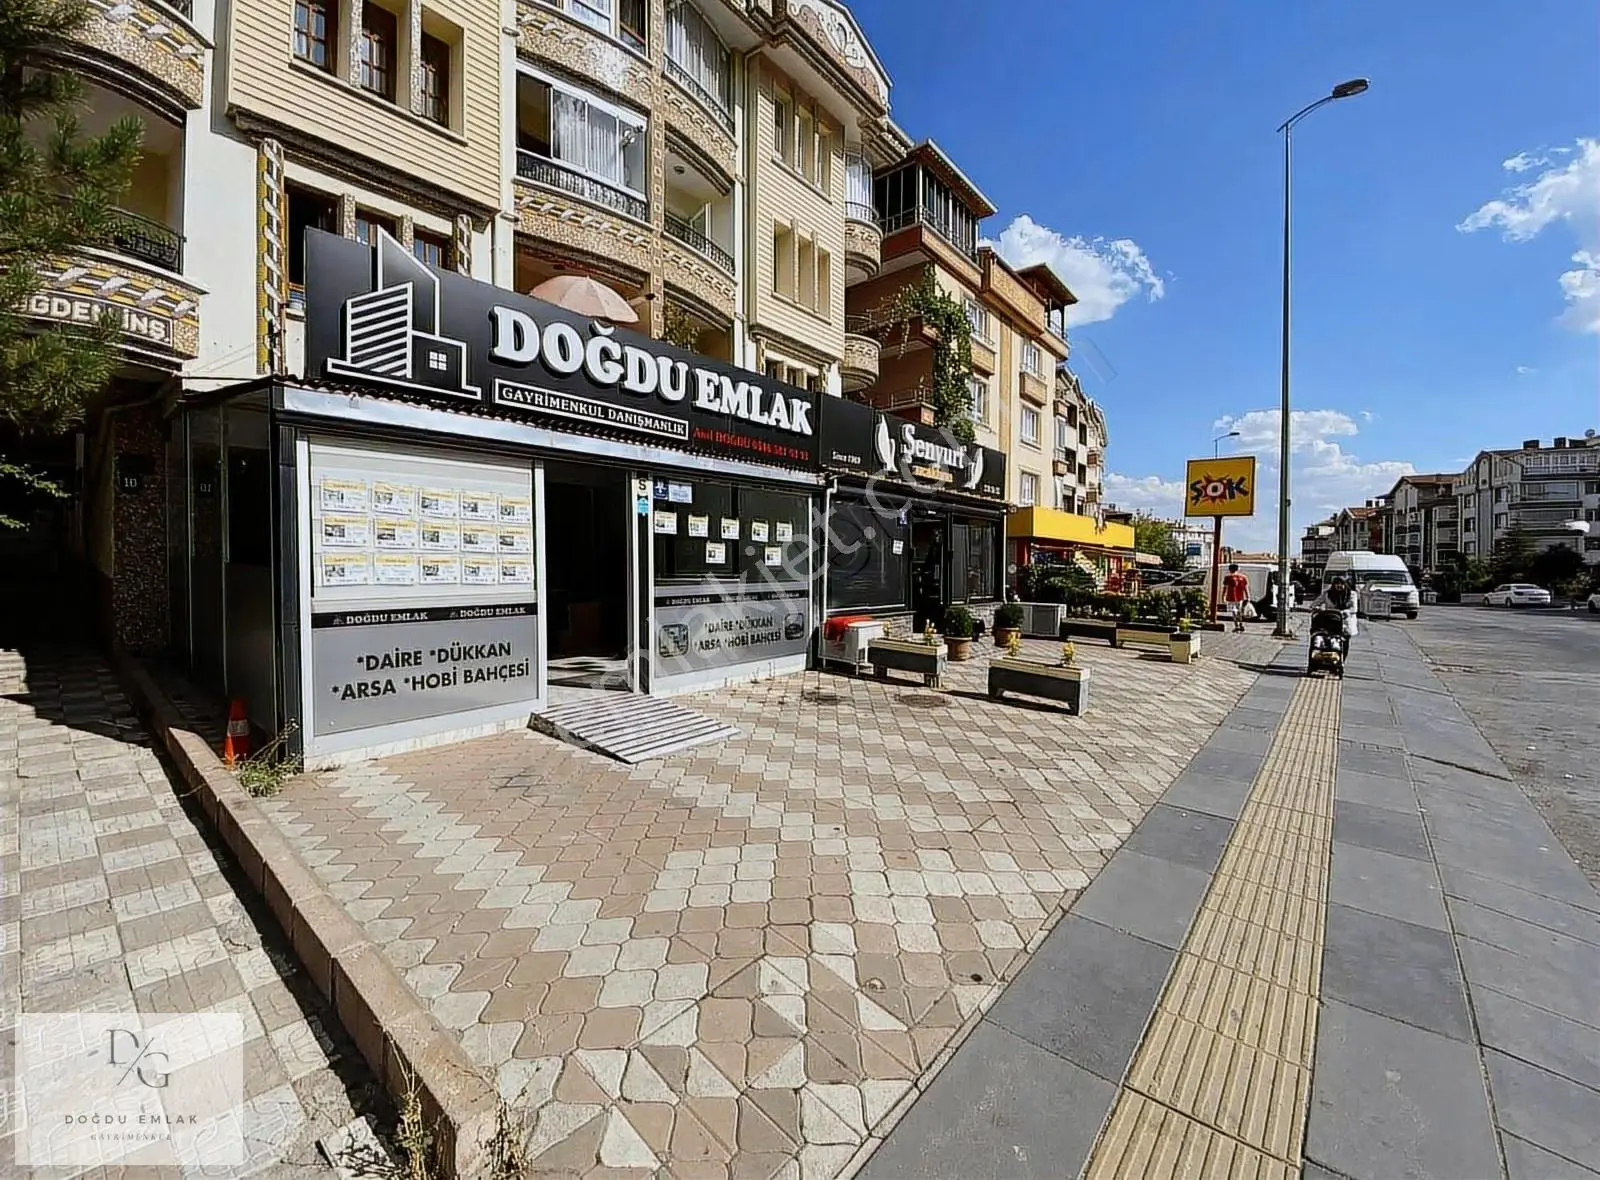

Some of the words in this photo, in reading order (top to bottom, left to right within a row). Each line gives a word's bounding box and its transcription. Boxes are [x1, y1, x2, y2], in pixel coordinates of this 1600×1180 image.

[492, 305, 689, 402] DOĞDU
[694, 368, 813, 436] EMLAK
[502, 387, 605, 419] GAYRİMENKUL
[607, 407, 685, 435] DANIŞMANLIK
[1189, 475, 1249, 506] ŞOK
[346, 613, 388, 625] DOĞDU
[390, 612, 428, 622] EMLAK
[463, 657, 530, 684] BAHÇESİ
